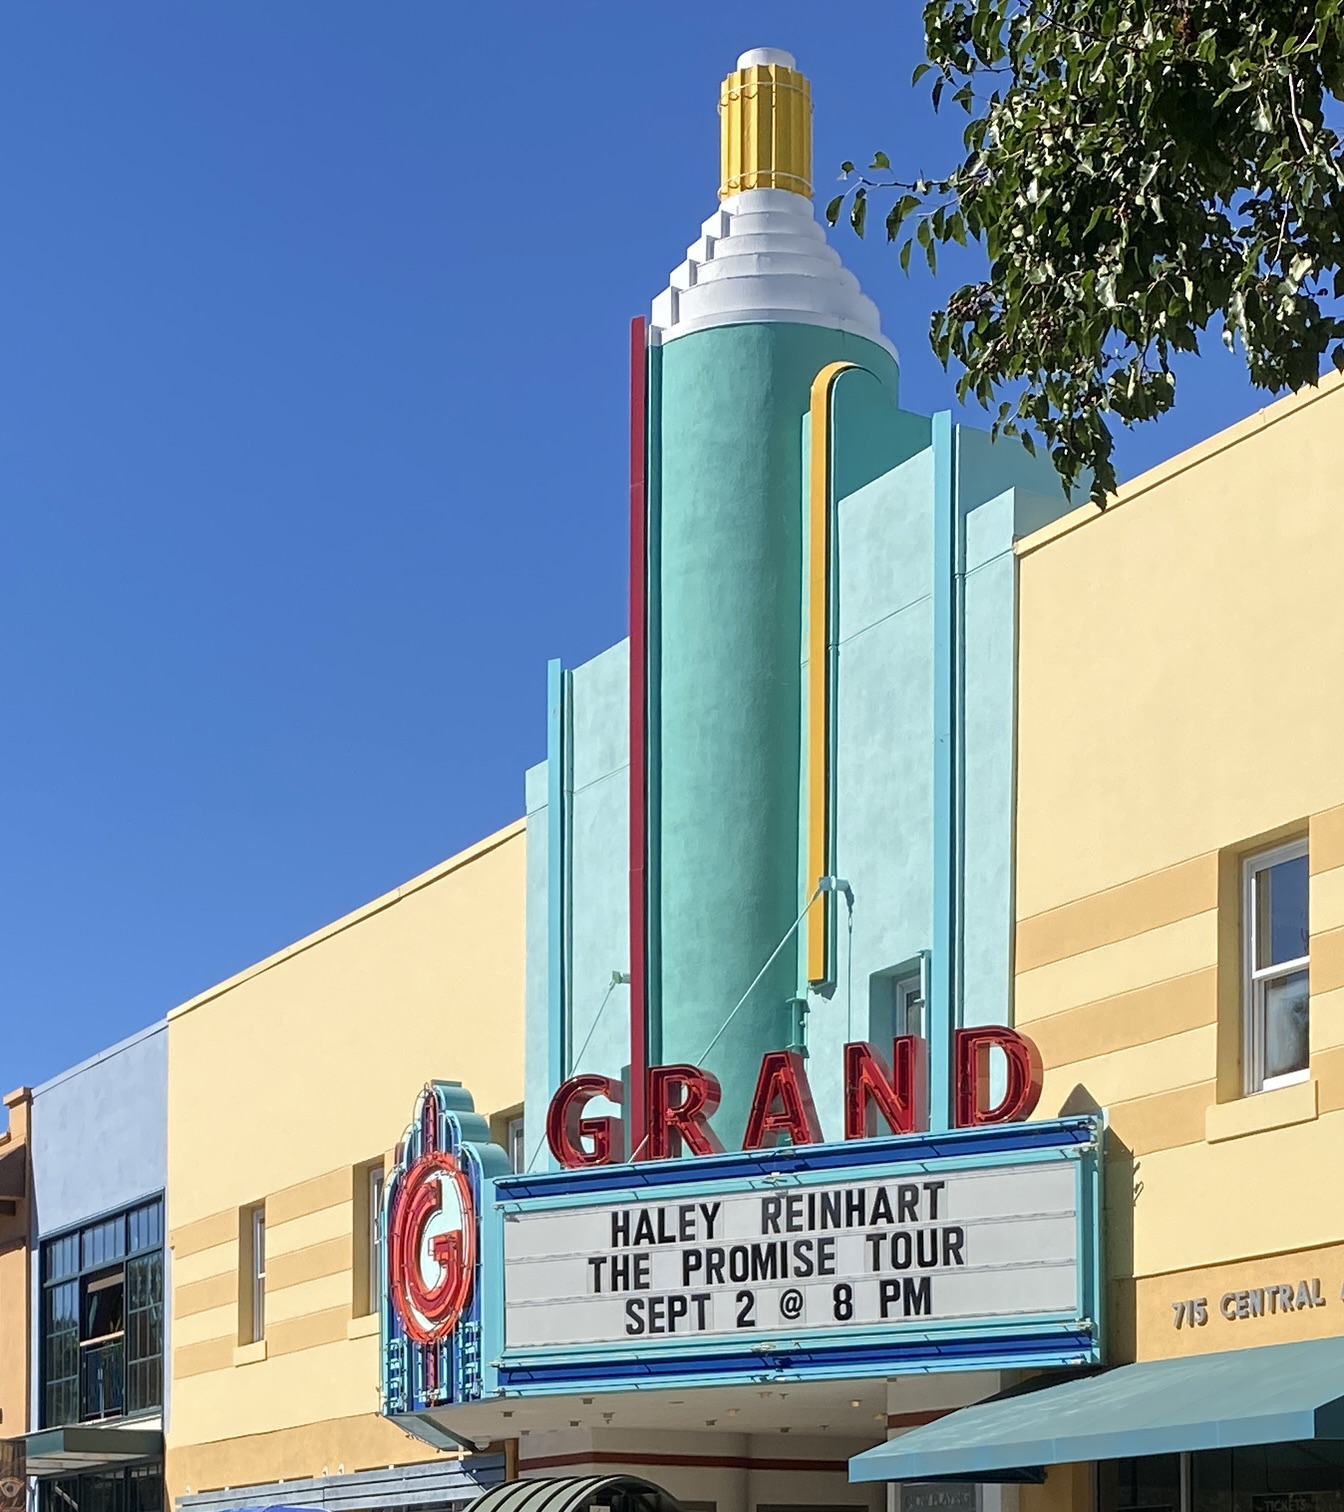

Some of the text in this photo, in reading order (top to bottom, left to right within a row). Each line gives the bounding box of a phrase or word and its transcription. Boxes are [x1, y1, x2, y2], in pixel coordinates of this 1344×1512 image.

[546, 1025, 1044, 1169] GRAND
[611, 1181, 945, 1248] HALEY REINHART
[588, 1226, 965, 1293] THE PROMISE TOUR
[625, 1276, 932, 1336] SEPT 2 @ 8 PM
[1171, 1297, 1207, 1330] 715
[1220, 1278, 1326, 1321] CENTRAL
[1264, 1498, 1306, 1512] TICKETS
